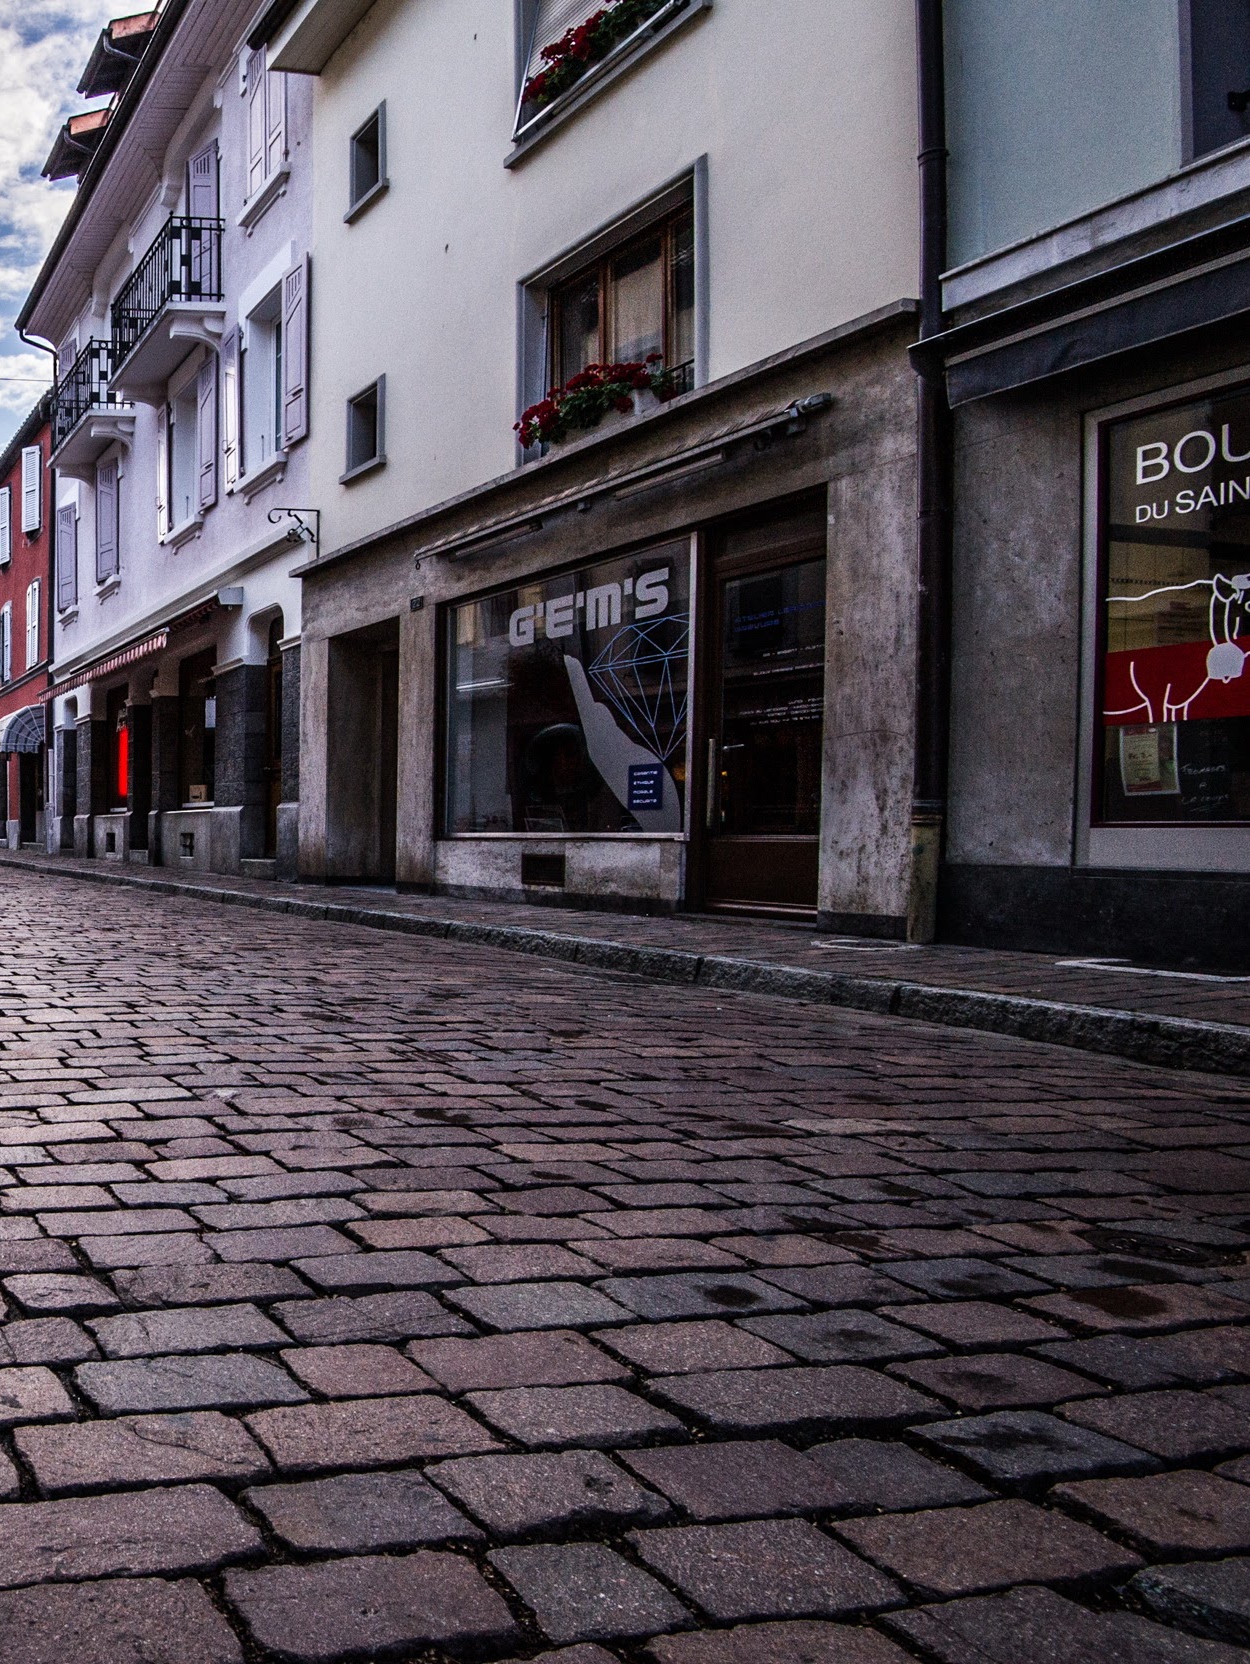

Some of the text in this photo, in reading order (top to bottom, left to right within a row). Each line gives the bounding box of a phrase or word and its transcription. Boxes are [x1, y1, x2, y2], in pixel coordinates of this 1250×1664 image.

[1137, 422, 1250, 486] BOU
[1136, 476, 1250, 524] DU SAIN
